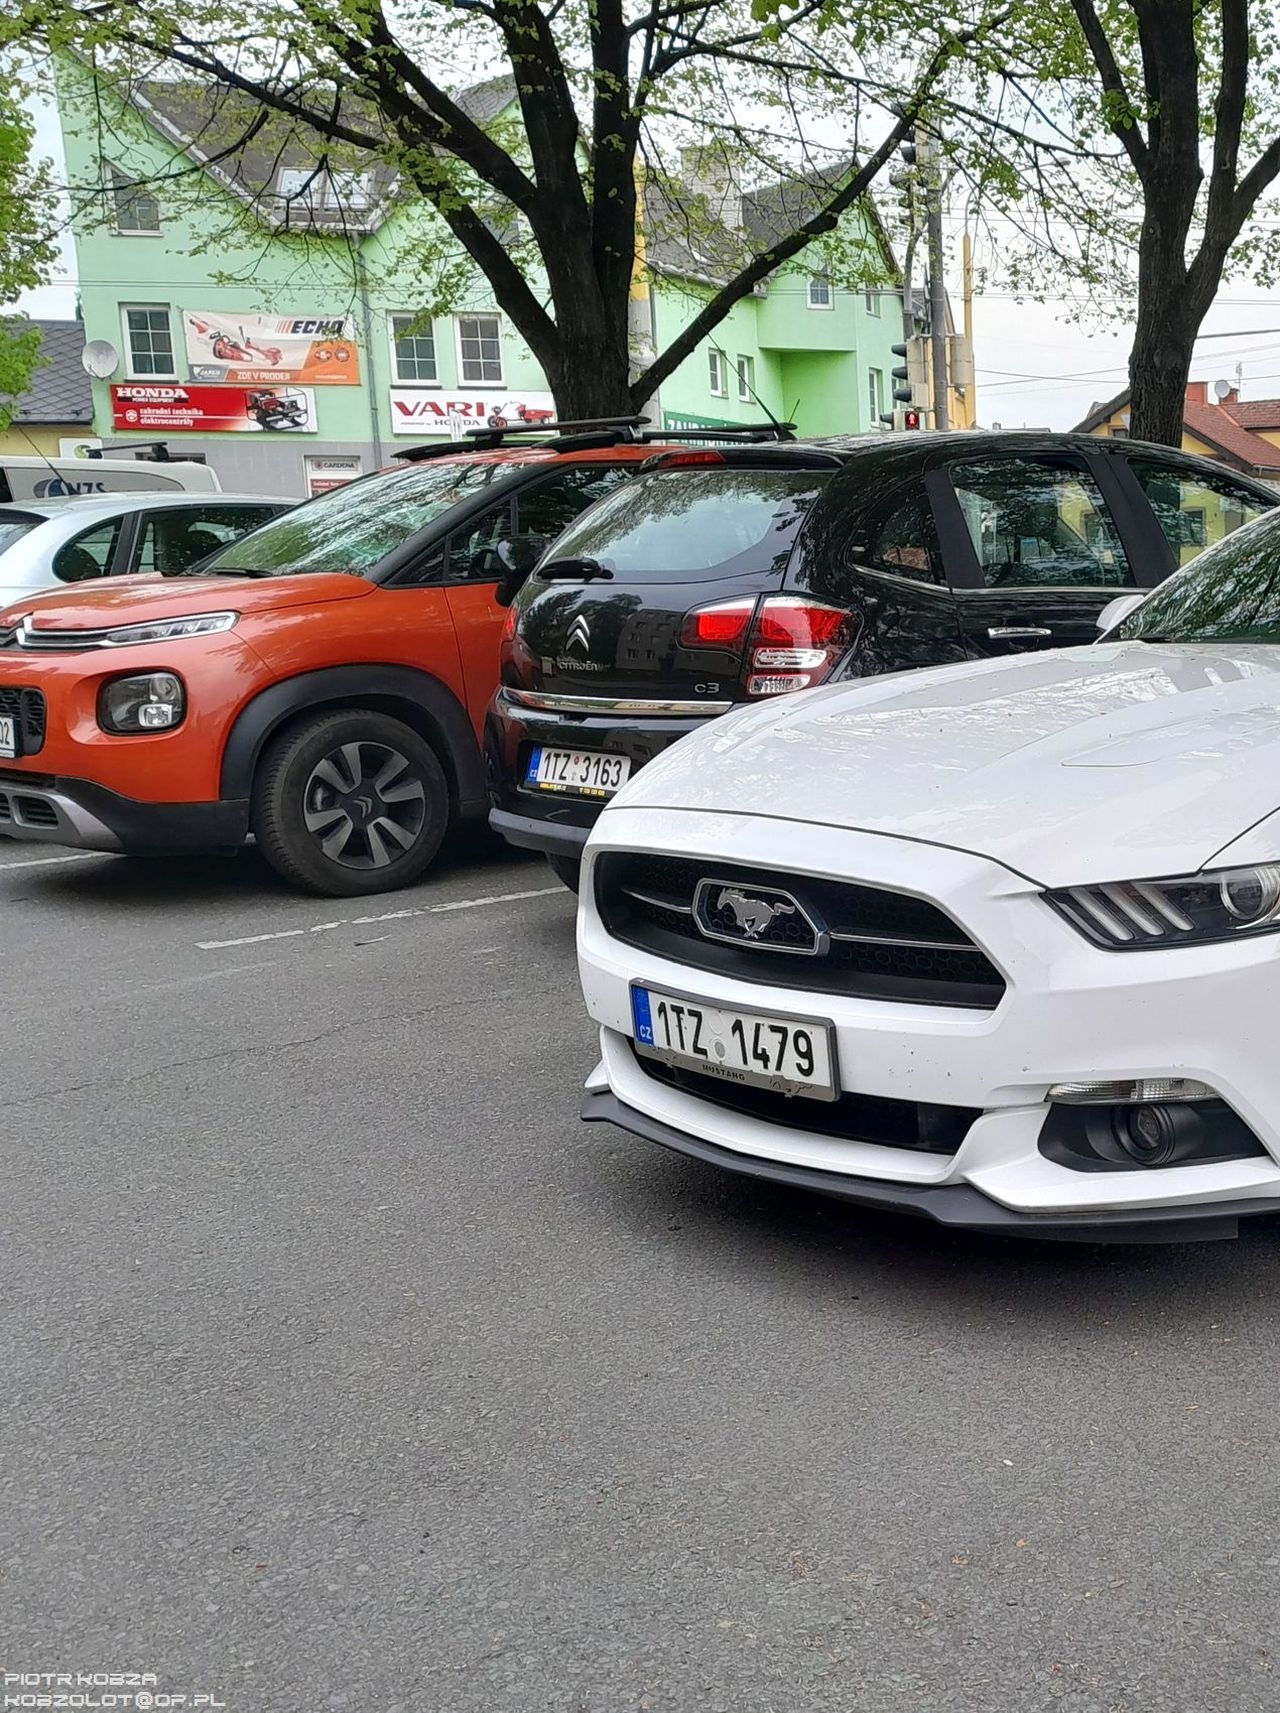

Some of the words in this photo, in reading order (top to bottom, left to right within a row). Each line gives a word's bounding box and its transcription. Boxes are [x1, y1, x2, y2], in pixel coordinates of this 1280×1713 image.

[291, 320, 344, 334] ECHO
[237, 371, 253, 380] ZDE
[116, 387, 189, 399] HONDA
[393, 401, 485, 417] VARI
[694, 682, 720, 693] C3
[544, 751, 571, 780] 1TZ
[580, 755, 622, 787] 3163
[639, 1024, 652, 1040] CZ
[657, 1001, 708, 1059] 1TZ
[731, 1019, 814, 1077] 1479
[702, 1064, 745, 1081] MUSTANG
